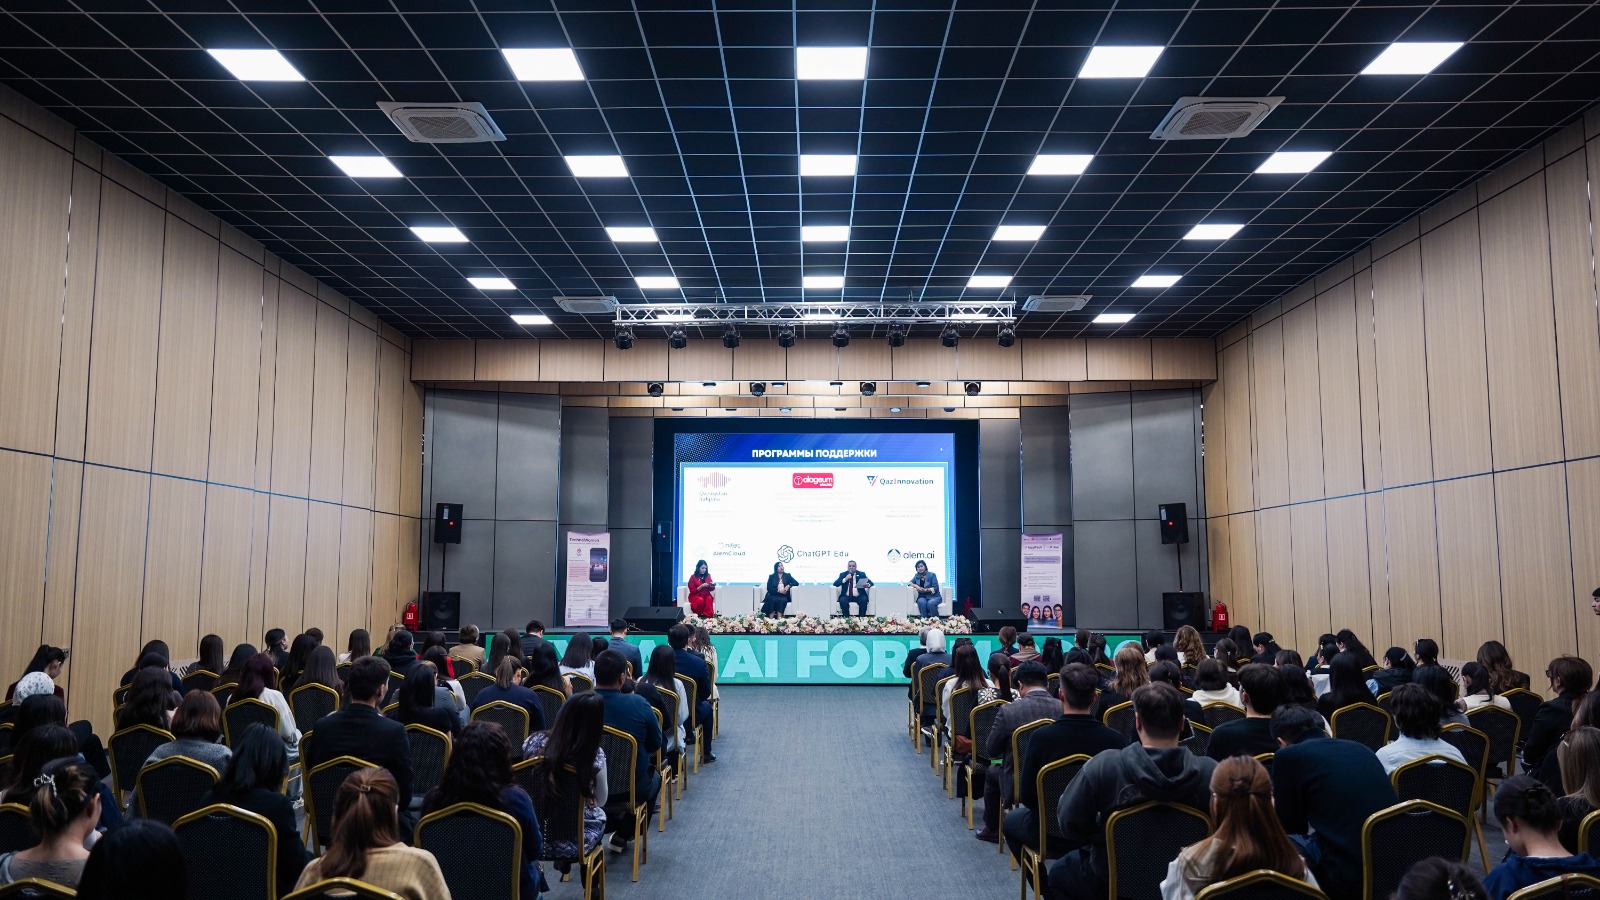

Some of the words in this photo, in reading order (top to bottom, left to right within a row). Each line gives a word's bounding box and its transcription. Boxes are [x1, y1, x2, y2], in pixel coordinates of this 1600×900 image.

[752, 449, 814, 458] ПРОГРАММЫ
[815, 449, 877, 459] ПОДДЕРЖКИ
[879, 478, 934, 486] QazInnovation
[796, 550, 831, 558] ChatGPT
[833, 550, 849, 558] Edu
[902, 550, 935, 560] alem.ai
[720, 639, 778, 678] AI
[796, 639, 992, 678] FOR
